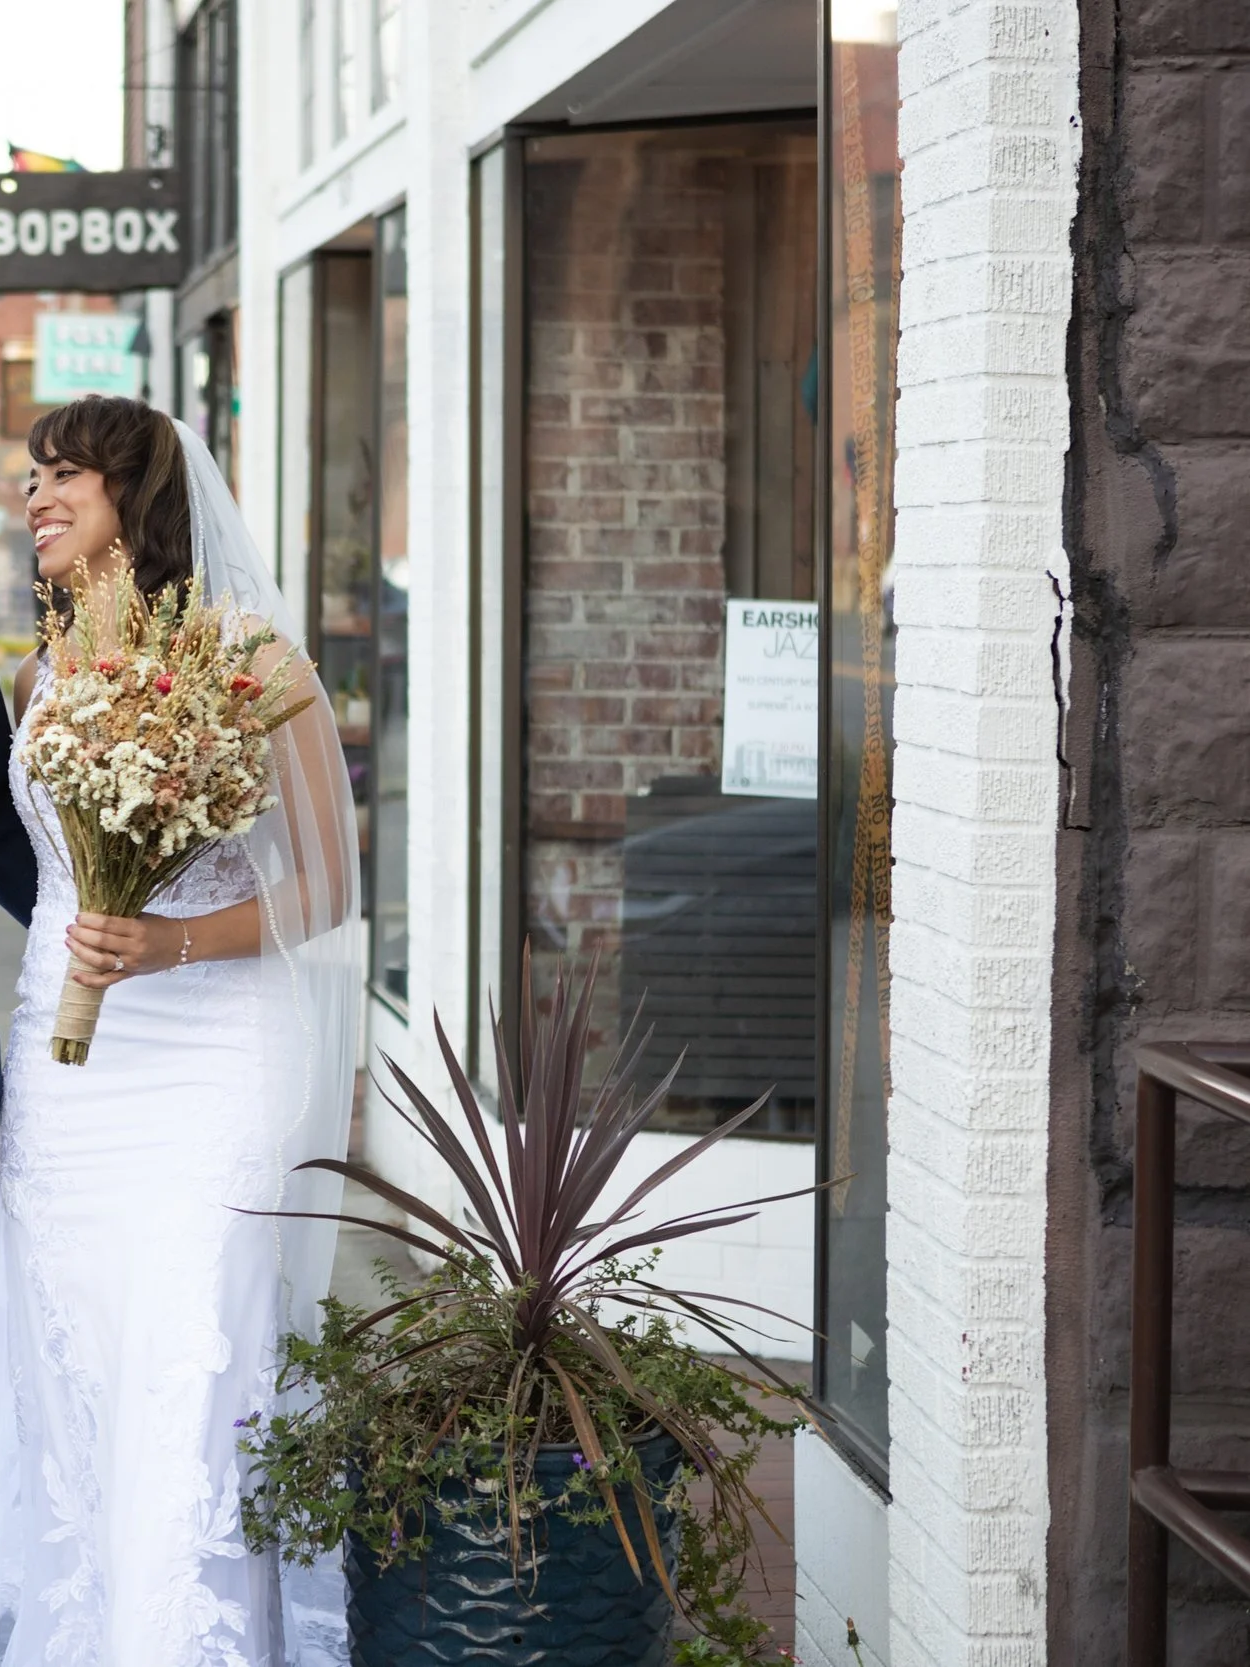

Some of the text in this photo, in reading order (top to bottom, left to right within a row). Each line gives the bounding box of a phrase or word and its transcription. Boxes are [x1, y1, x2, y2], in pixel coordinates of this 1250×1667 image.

[742, 610, 819, 629] EARSH
[763, 631, 819, 660] JAZ
[871, 791, 891, 1020] NO TRESPASSING
